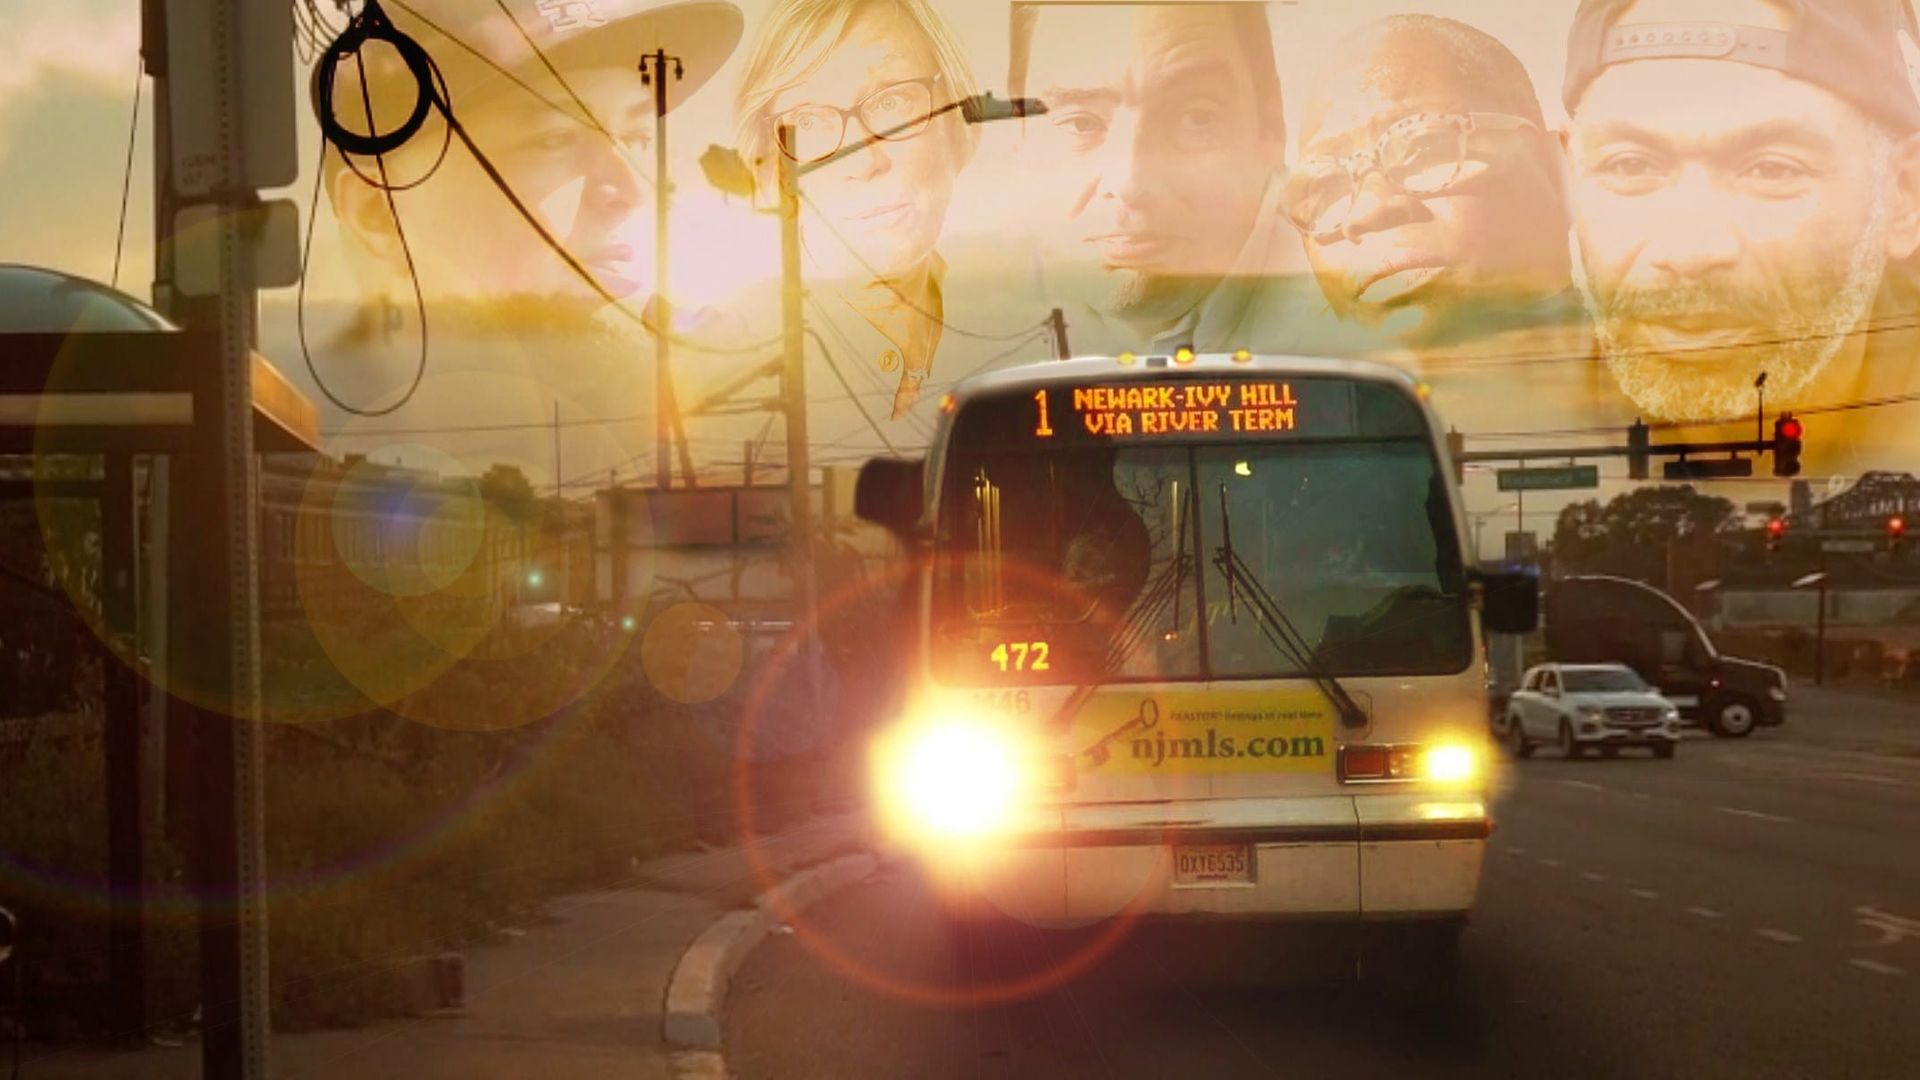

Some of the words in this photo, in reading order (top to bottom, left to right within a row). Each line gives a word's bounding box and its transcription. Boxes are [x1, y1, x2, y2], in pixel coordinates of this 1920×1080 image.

[1034, 389, 1053, 436] 1
[1073, 385, 1231, 410] NEWARK-IVY
[1240, 384, 1297, 405] HILL
[1084, 412, 1132, 434] VIA
[1140, 411, 1219, 433] RIVER
[1228, 408, 1295, 431] TERM
[991, 642, 1049, 672] 472
[1130, 729, 1324, 767] njmls.com
